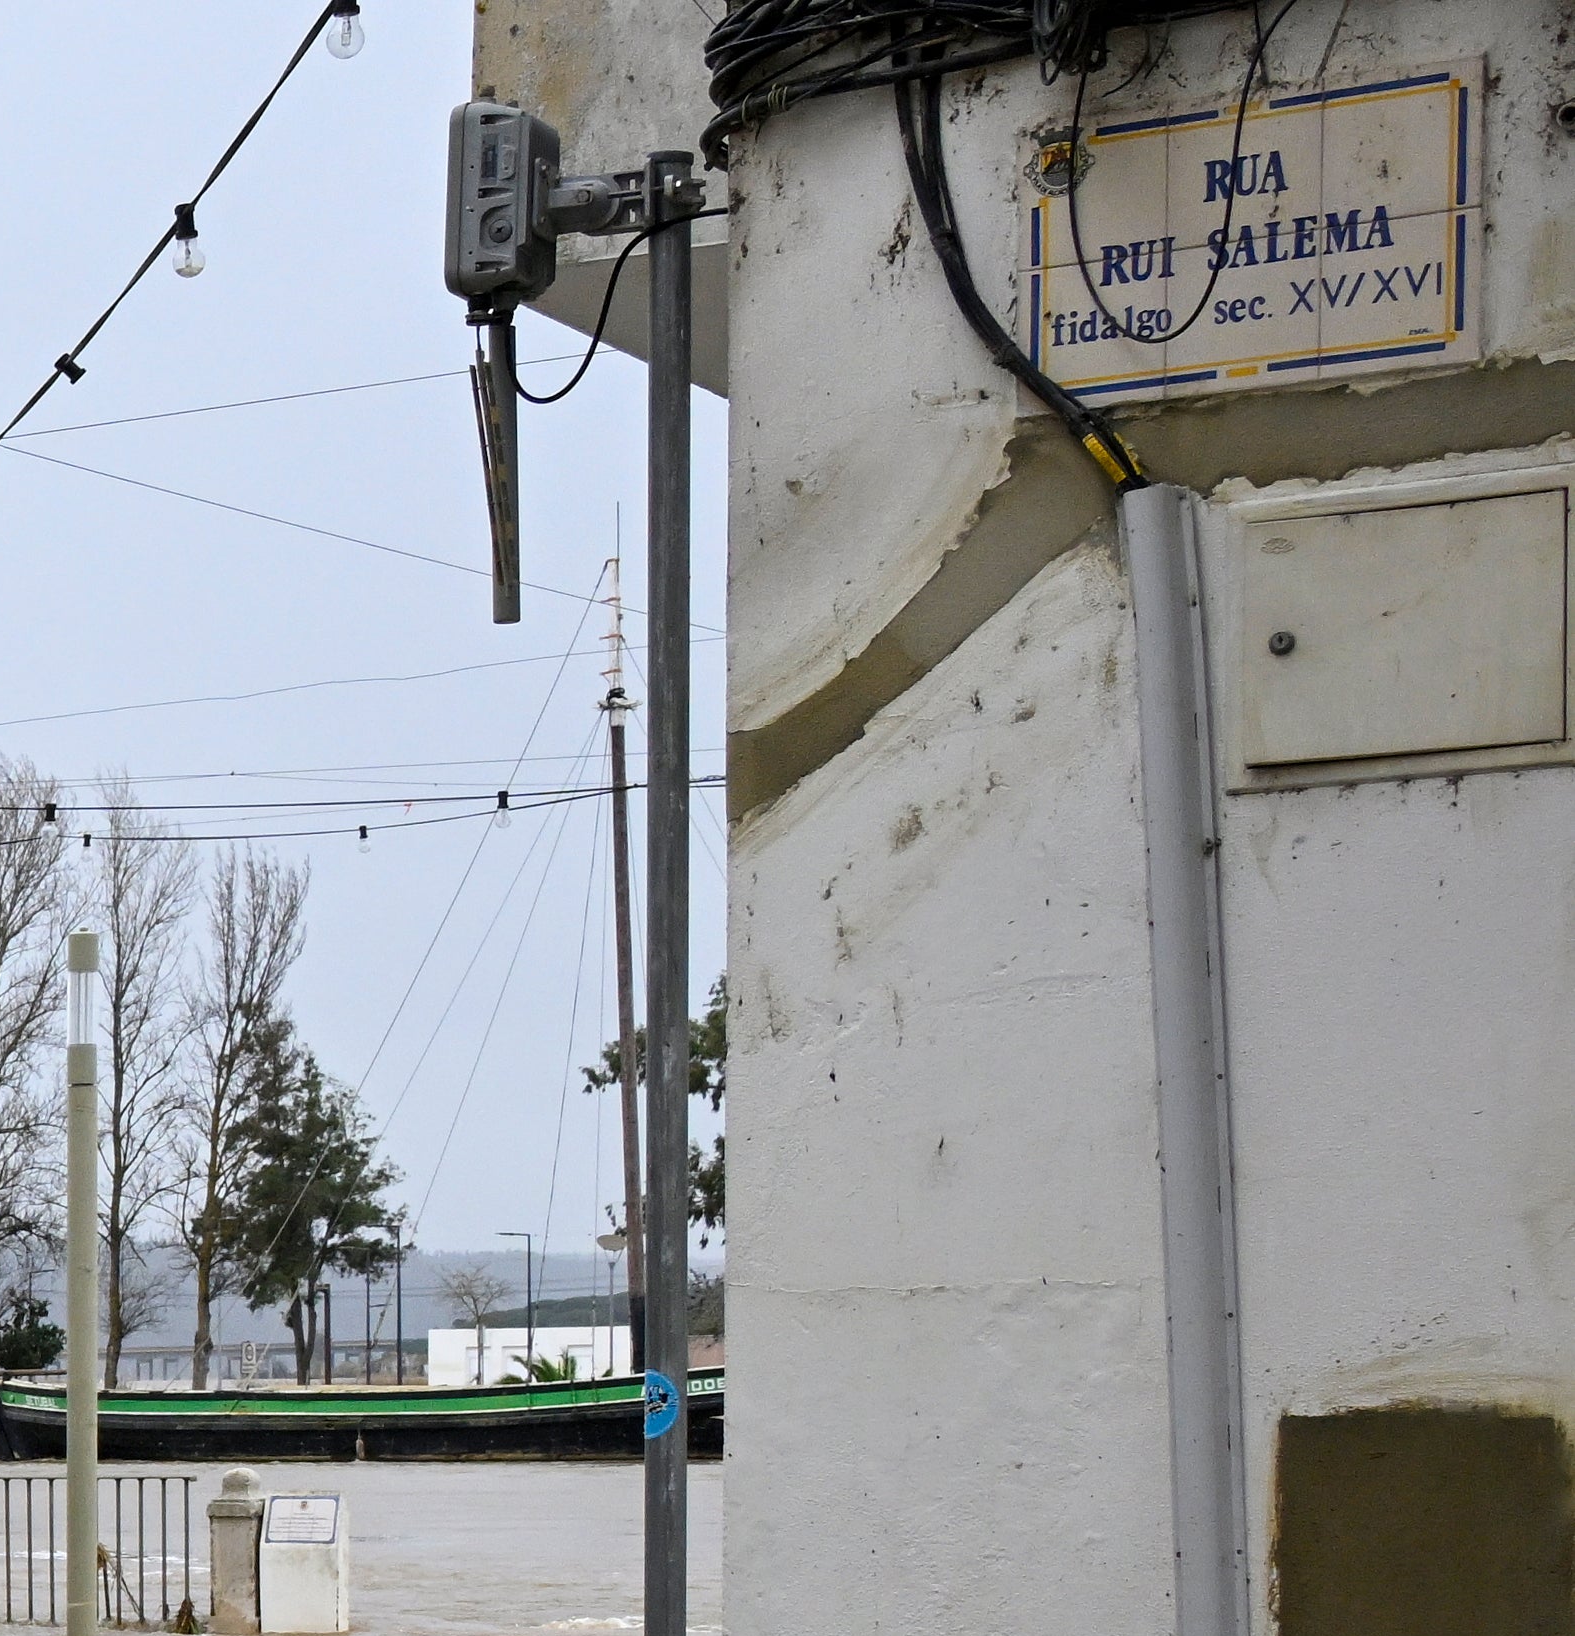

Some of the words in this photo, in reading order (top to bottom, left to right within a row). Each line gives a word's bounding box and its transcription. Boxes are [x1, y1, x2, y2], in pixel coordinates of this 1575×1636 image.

[1203, 149, 1288, 203] RUA
[1099, 236, 1176, 287] RUI
[1207, 205, 1395, 271] SALEMA
[1051, 303, 1173, 347] fidalgo
[1214, 292, 1274, 325] sec.
[1289, 261, 1443, 316] XV/XVI
